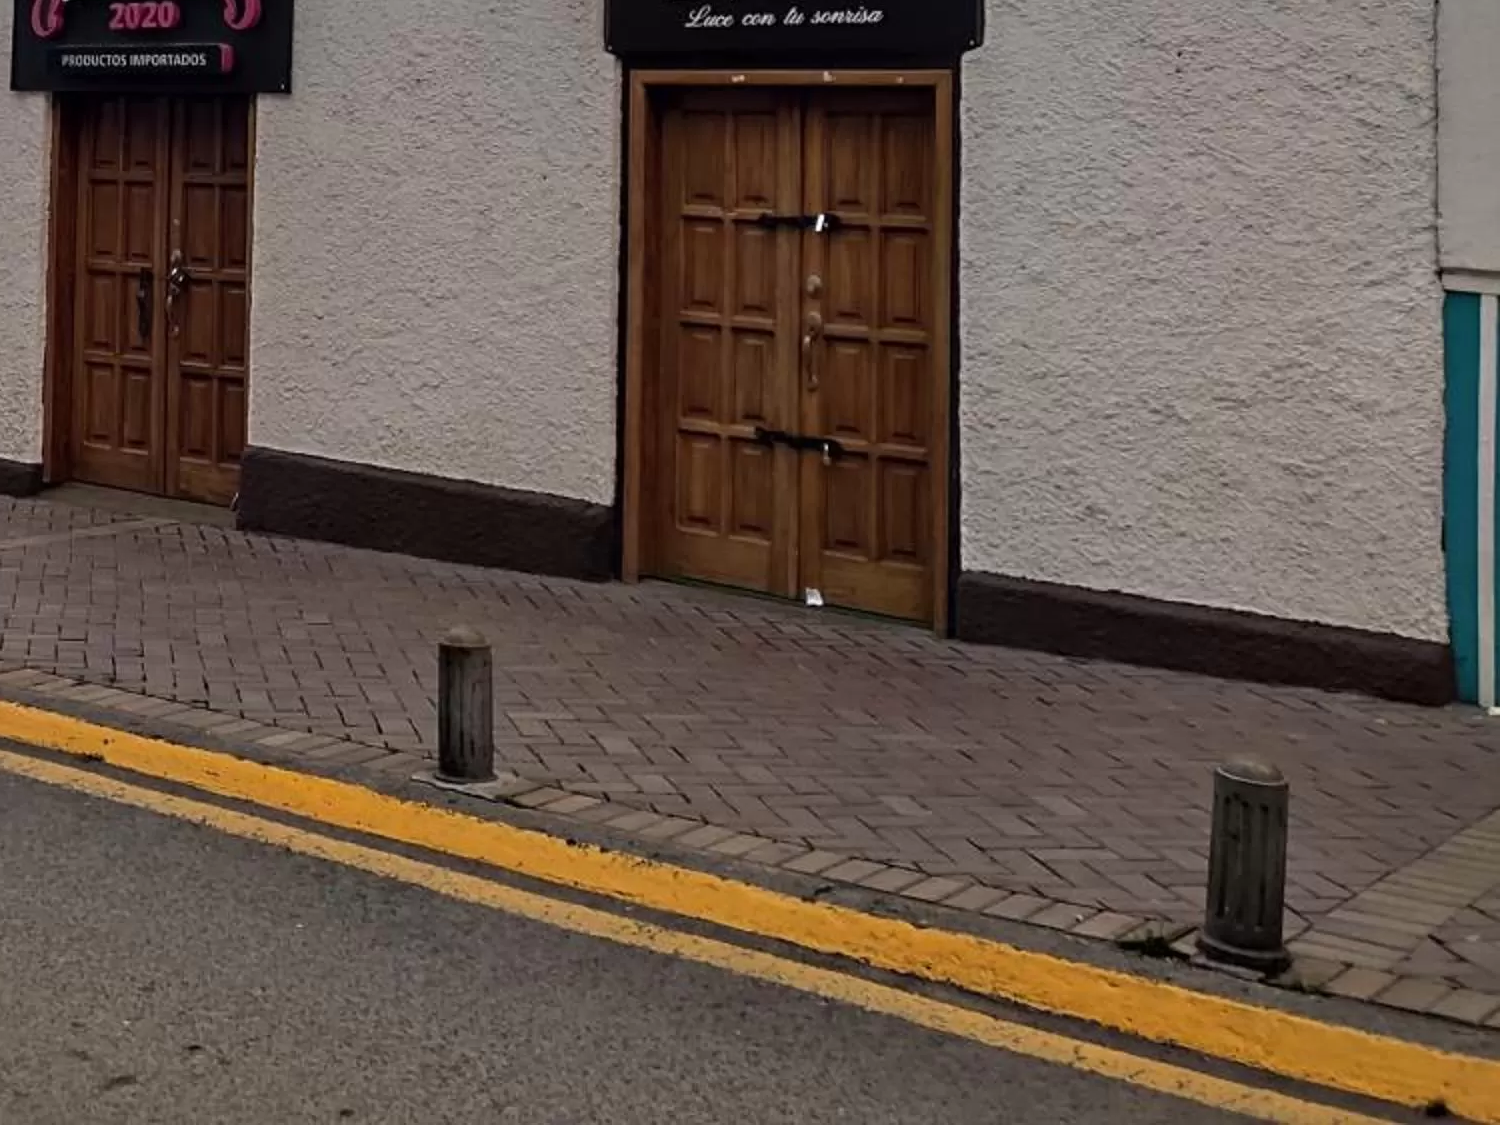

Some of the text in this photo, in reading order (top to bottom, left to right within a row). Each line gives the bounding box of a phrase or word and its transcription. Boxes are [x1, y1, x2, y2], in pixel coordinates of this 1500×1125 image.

[108, 1, 181, 29] 2020
[684, 5, 885, 28] Luce con tu sonrisa
[61, 53, 207, 68] PRODUCTOS IMPORTADOS
